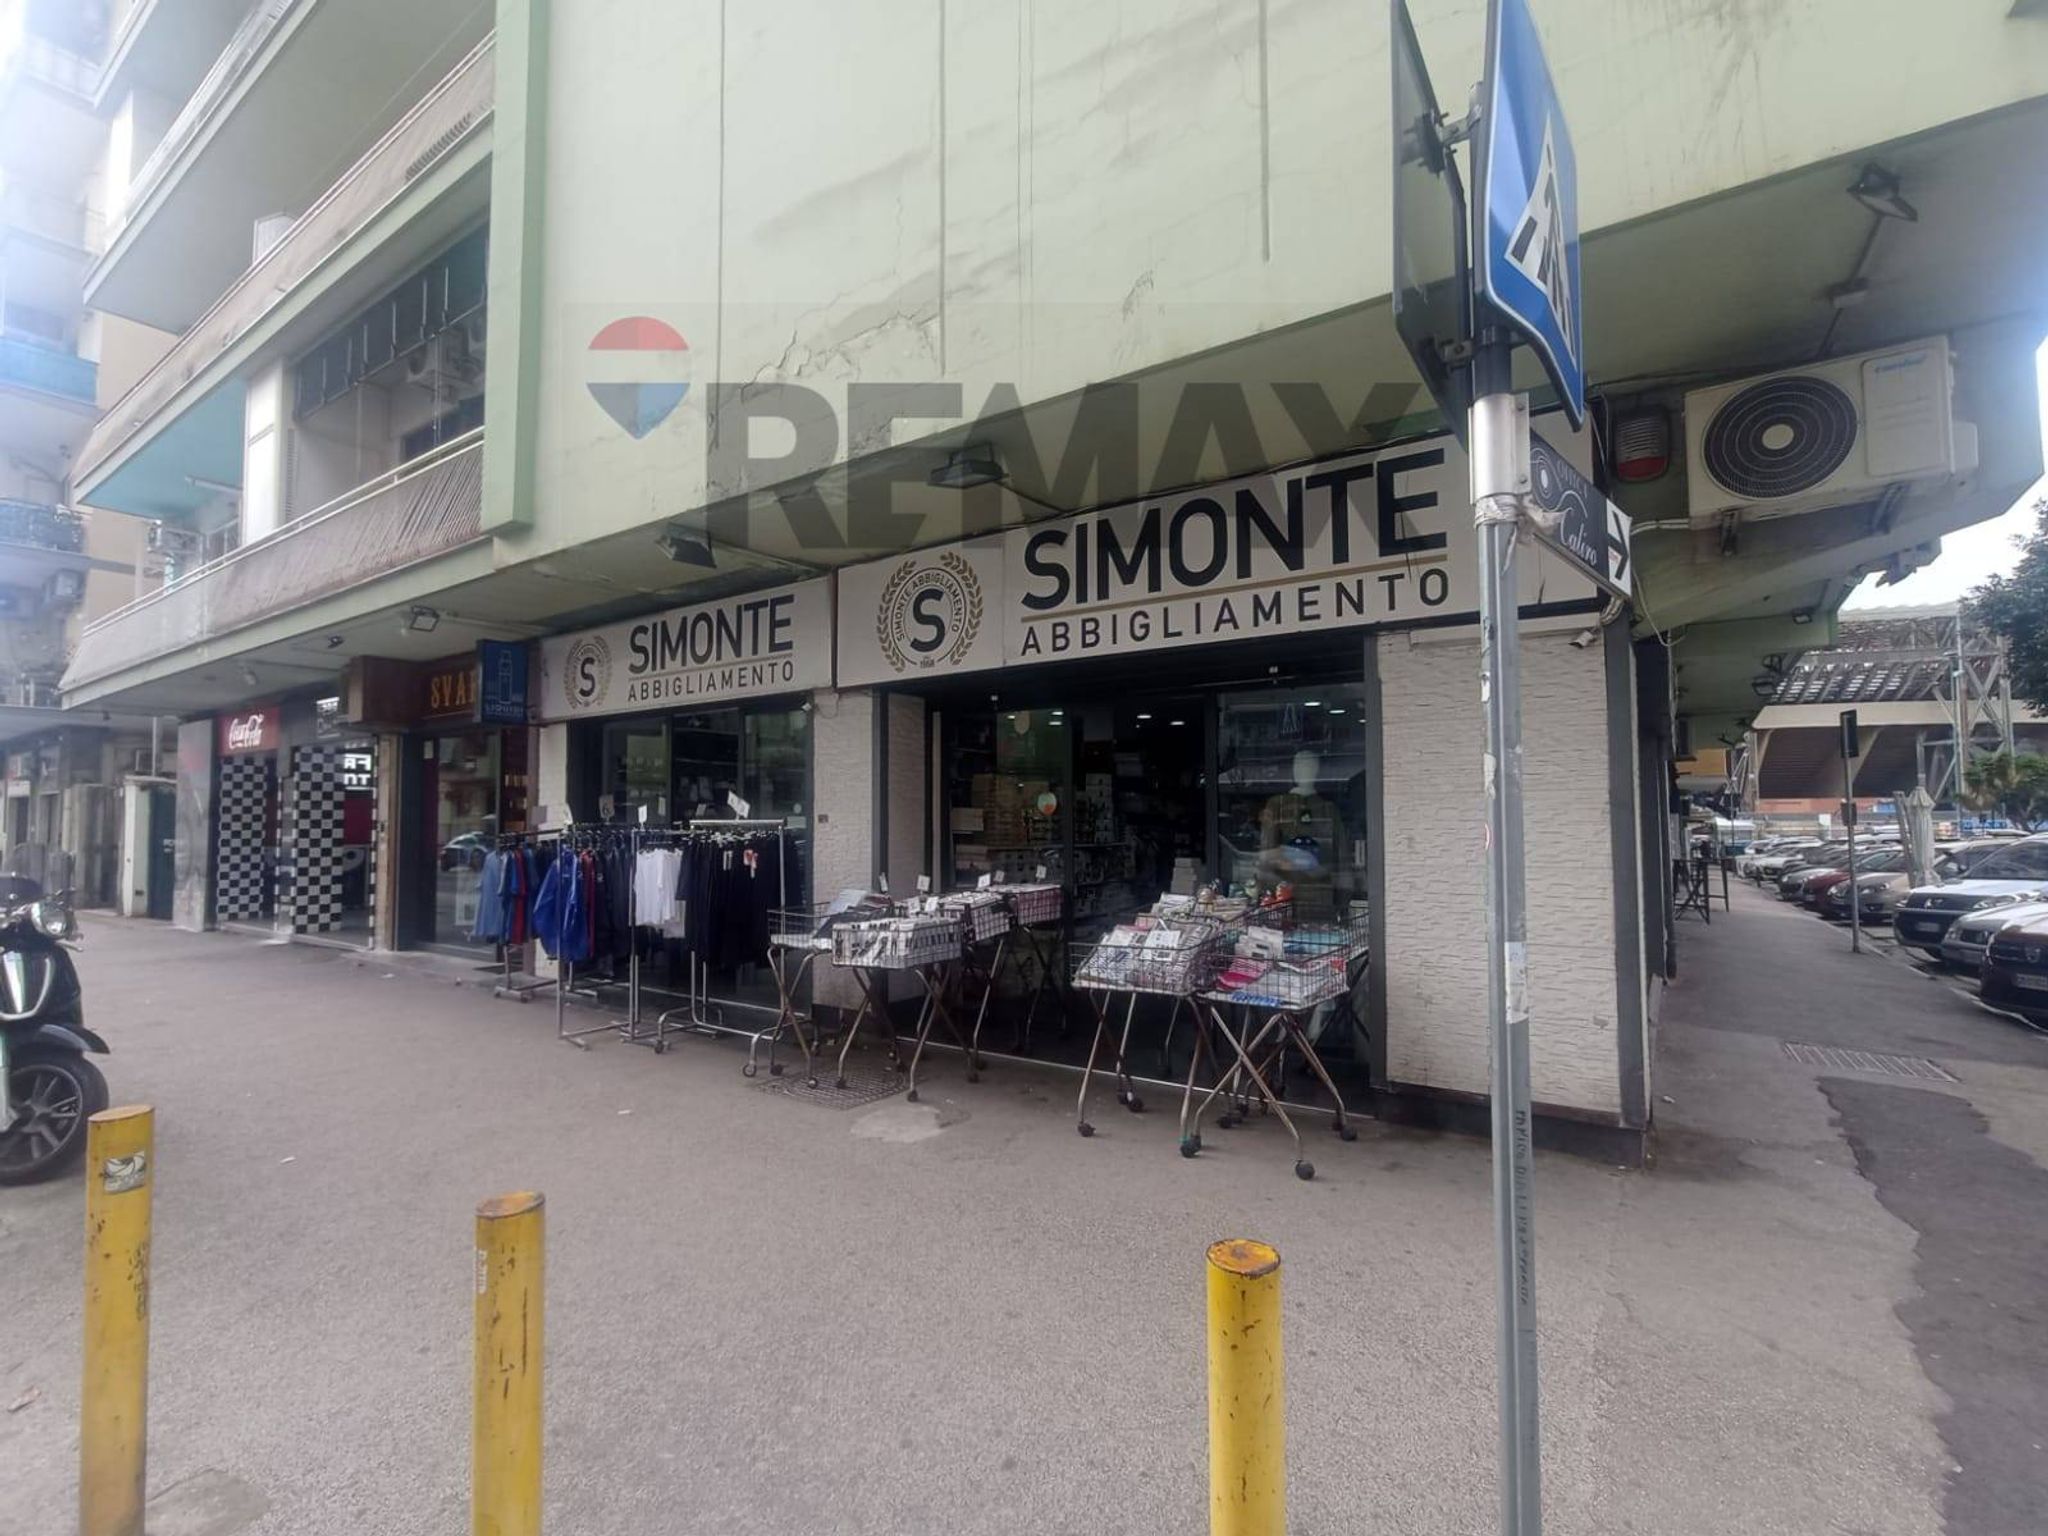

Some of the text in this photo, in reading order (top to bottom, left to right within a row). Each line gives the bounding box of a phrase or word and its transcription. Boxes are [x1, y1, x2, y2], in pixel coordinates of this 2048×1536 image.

[1021, 448, 1447, 610] SIMONTE
[628, 594, 795, 675] SIMONTE
[894, 573, 963, 642] SIMONTE ABBIGLIAMENTO
[910, 588, 945, 653] S
[1021, 568, 1449, 656] ABBIGLIAMENTO
[579, 657, 596, 698] S
[628, 660, 794, 702] ABBIGLIAMENTO
